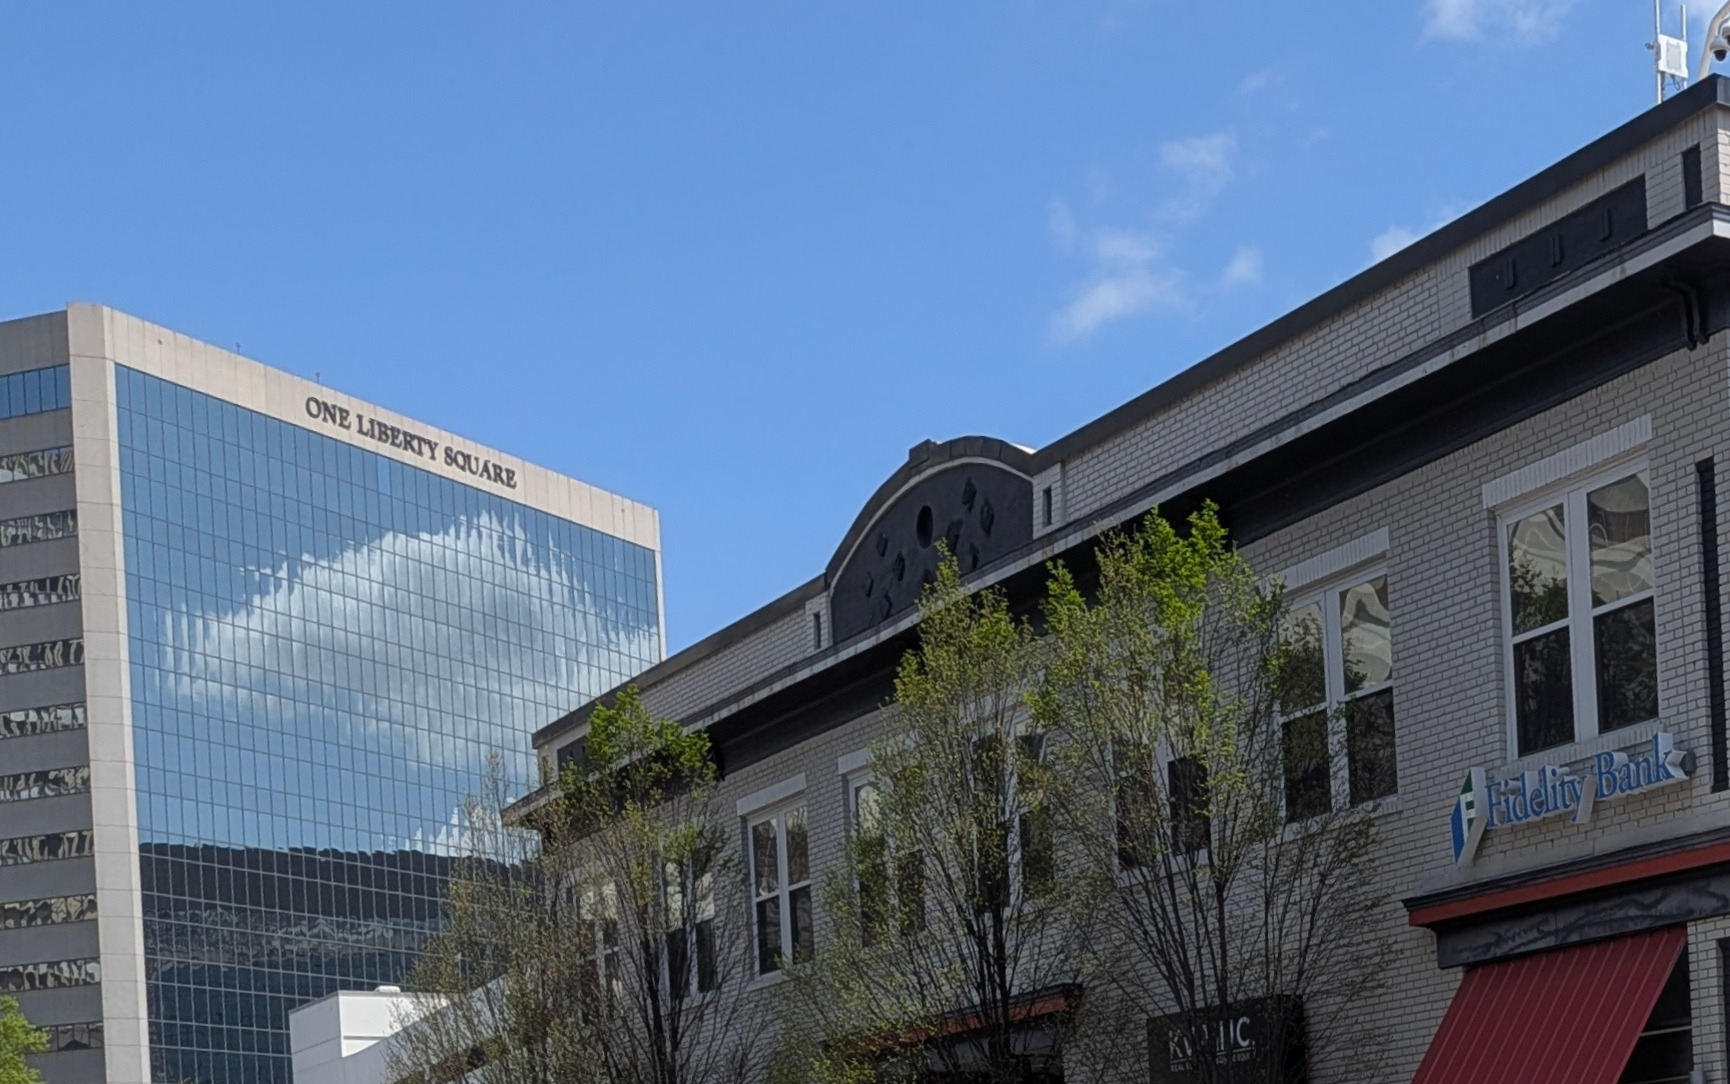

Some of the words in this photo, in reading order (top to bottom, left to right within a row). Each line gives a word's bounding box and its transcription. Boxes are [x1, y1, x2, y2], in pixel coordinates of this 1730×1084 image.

[305, 397, 351, 430] ONE
[355, 413, 439, 461] LIBERTY
[444, 446, 517, 489] SQUARE
[1485, 765, 1590, 830] Fidelity
[1595, 734, 1674, 799] Bank
